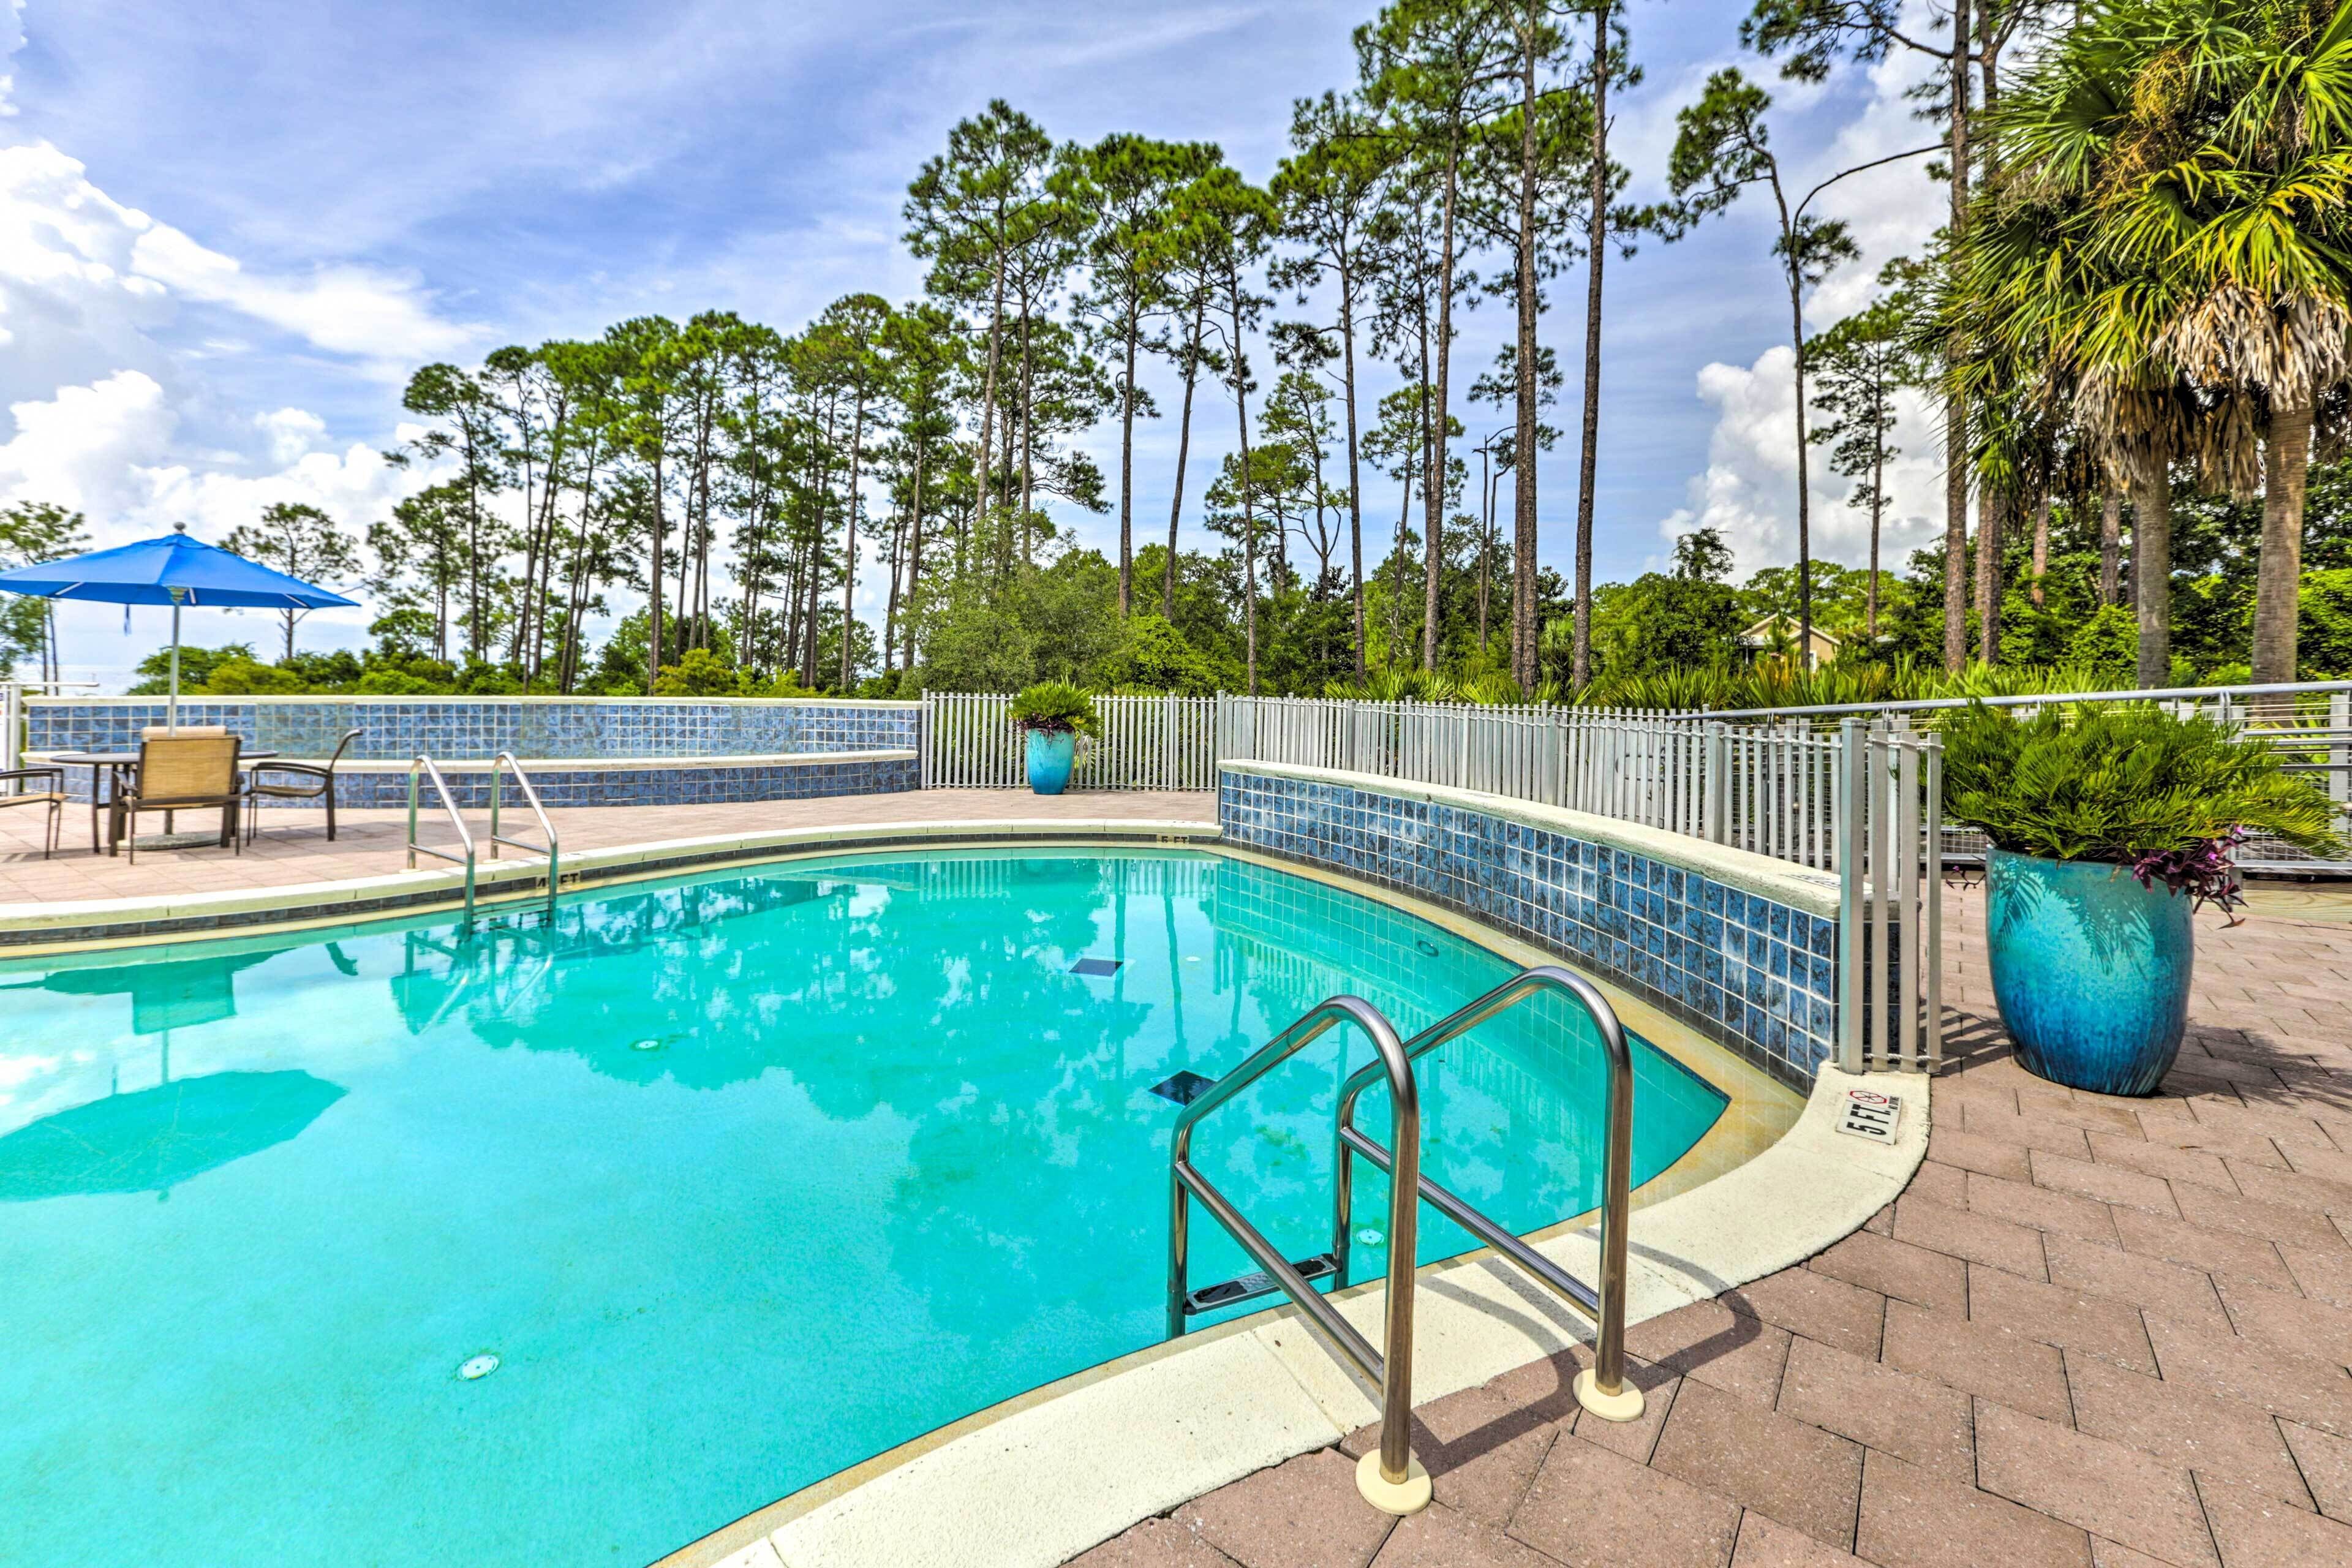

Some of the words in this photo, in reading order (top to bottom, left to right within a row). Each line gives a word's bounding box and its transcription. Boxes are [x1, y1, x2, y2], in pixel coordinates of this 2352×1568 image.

[1174, 835, 1188, 844] FT
[560, 873, 579, 884] FT
[1846, 1121, 1887, 1135] 5
